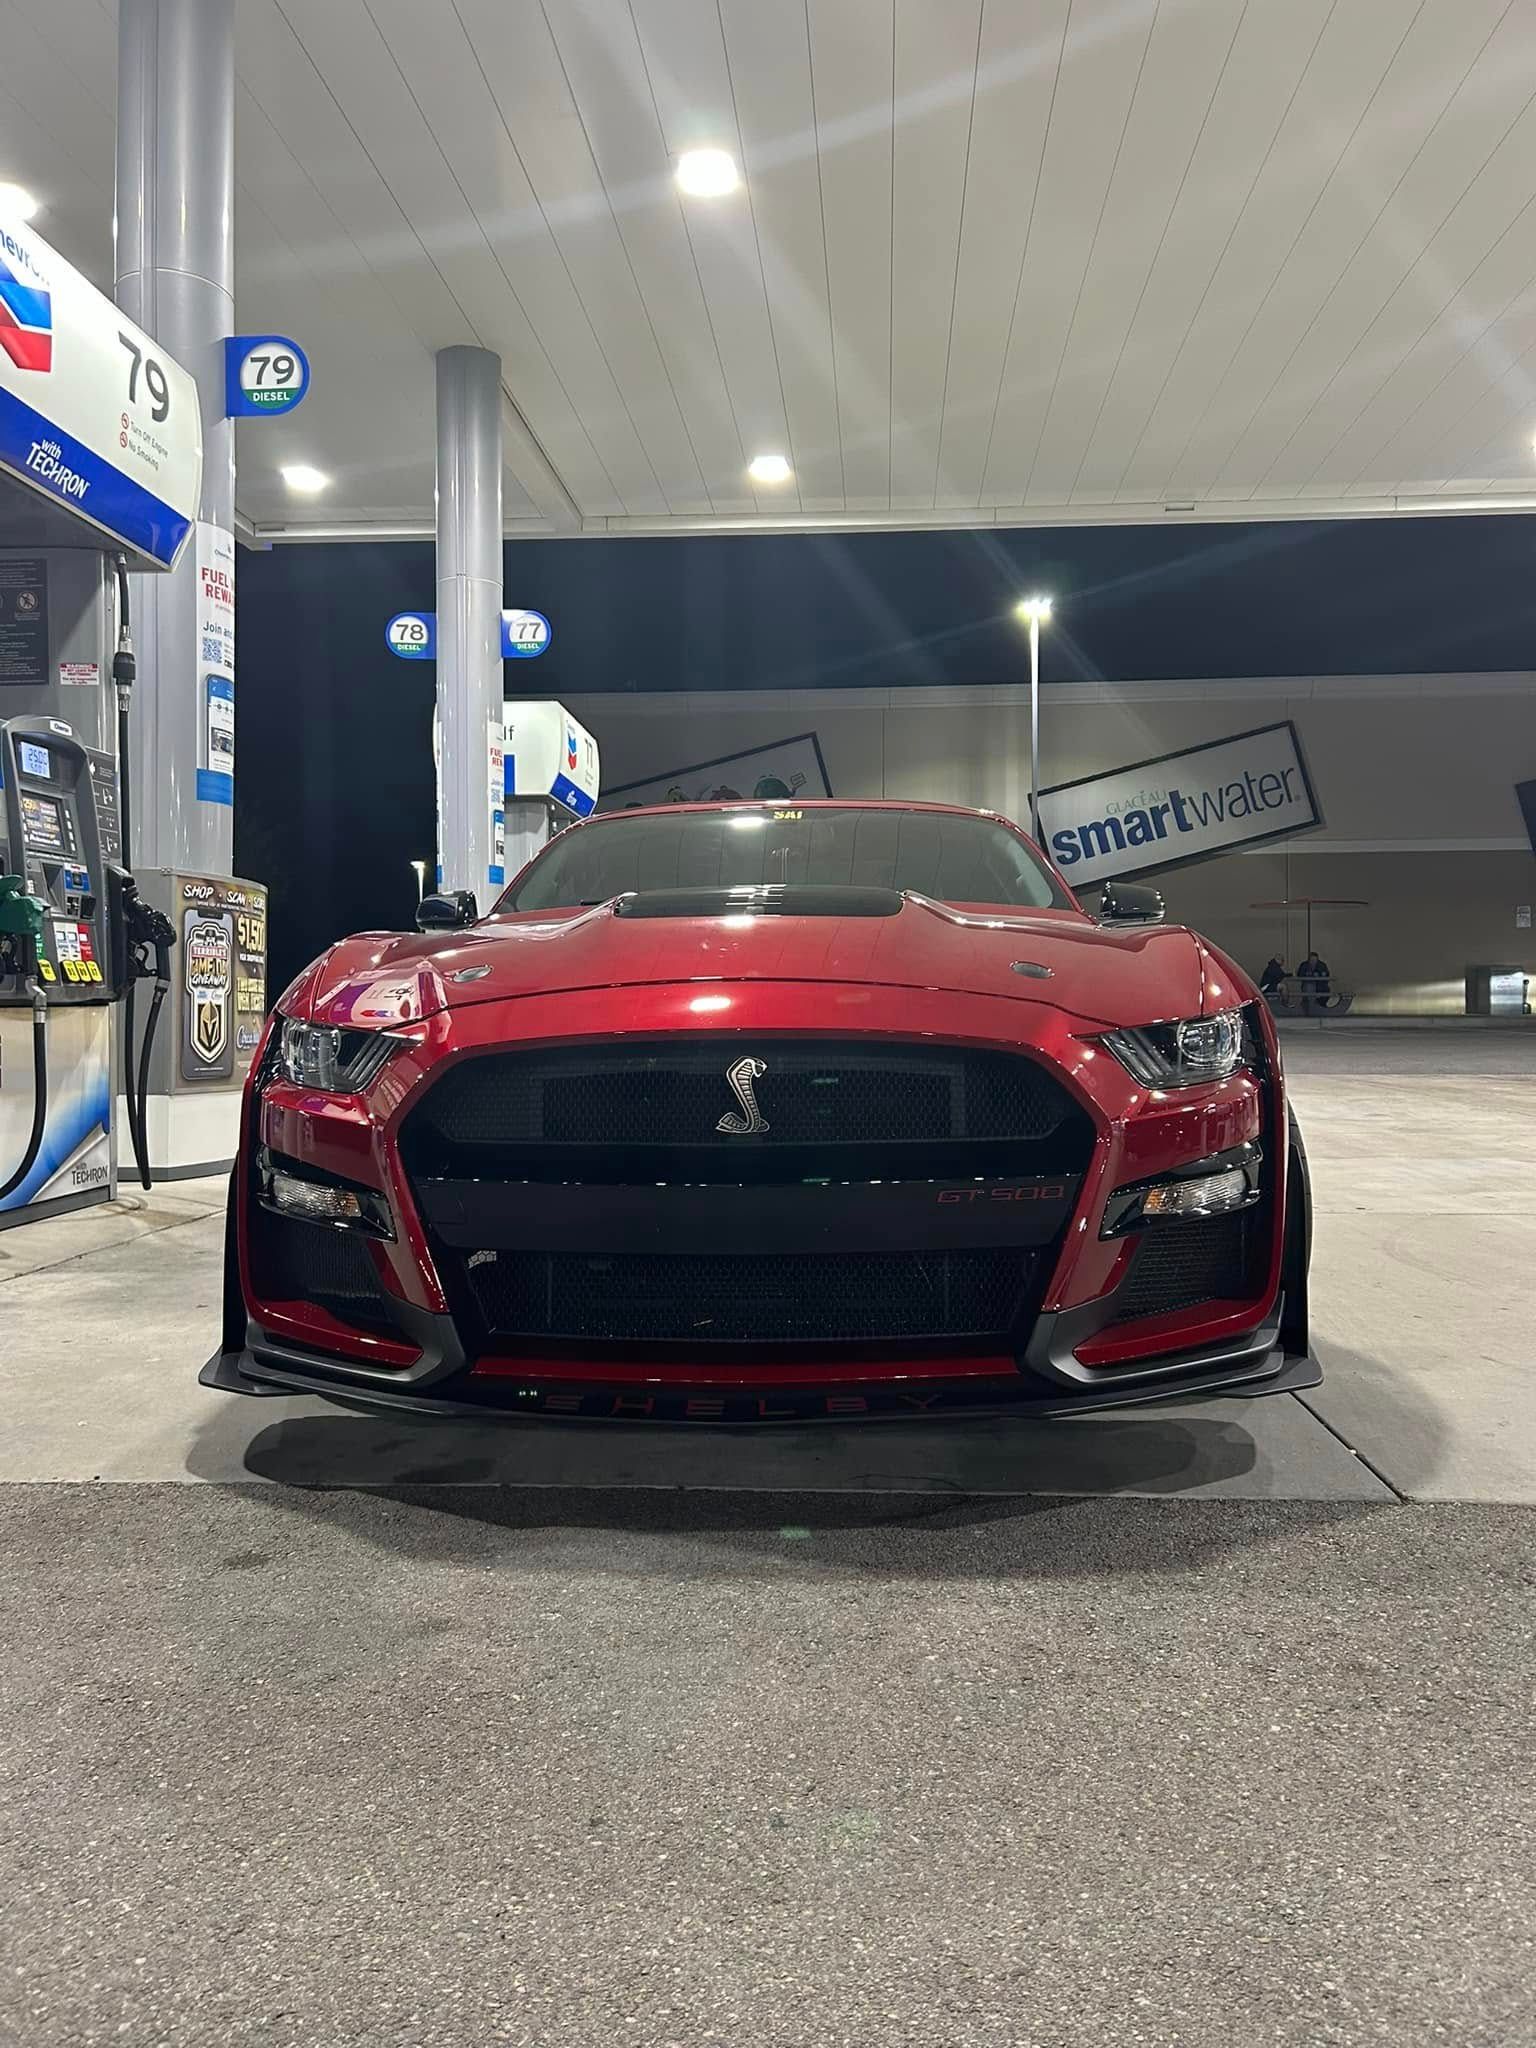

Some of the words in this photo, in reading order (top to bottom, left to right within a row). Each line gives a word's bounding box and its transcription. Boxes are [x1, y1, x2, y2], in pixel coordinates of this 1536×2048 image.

[118, 330, 170, 423] 79
[250, 355, 295, 386] 79
[252, 391, 290, 402] DIESEL
[41, 438, 62, 460] with
[25, 441, 91, 499] TECHRON
[201, 566, 229, 589] FUEL
[203, 620, 223, 635] Join
[396, 623, 424, 642] 78
[516, 622, 542, 640] 77
[397, 643, 422, 652] DIESEL
[516, 643, 540, 651] DIESEL
[184, 884, 214, 900] SHOP
[226, 891, 247, 906] SCAN
[191, 974, 227, 987] GIVEAWAY
[71, 1164, 109, 1185] TECHRON
[543, 1394, 943, 1416] SHELBY
